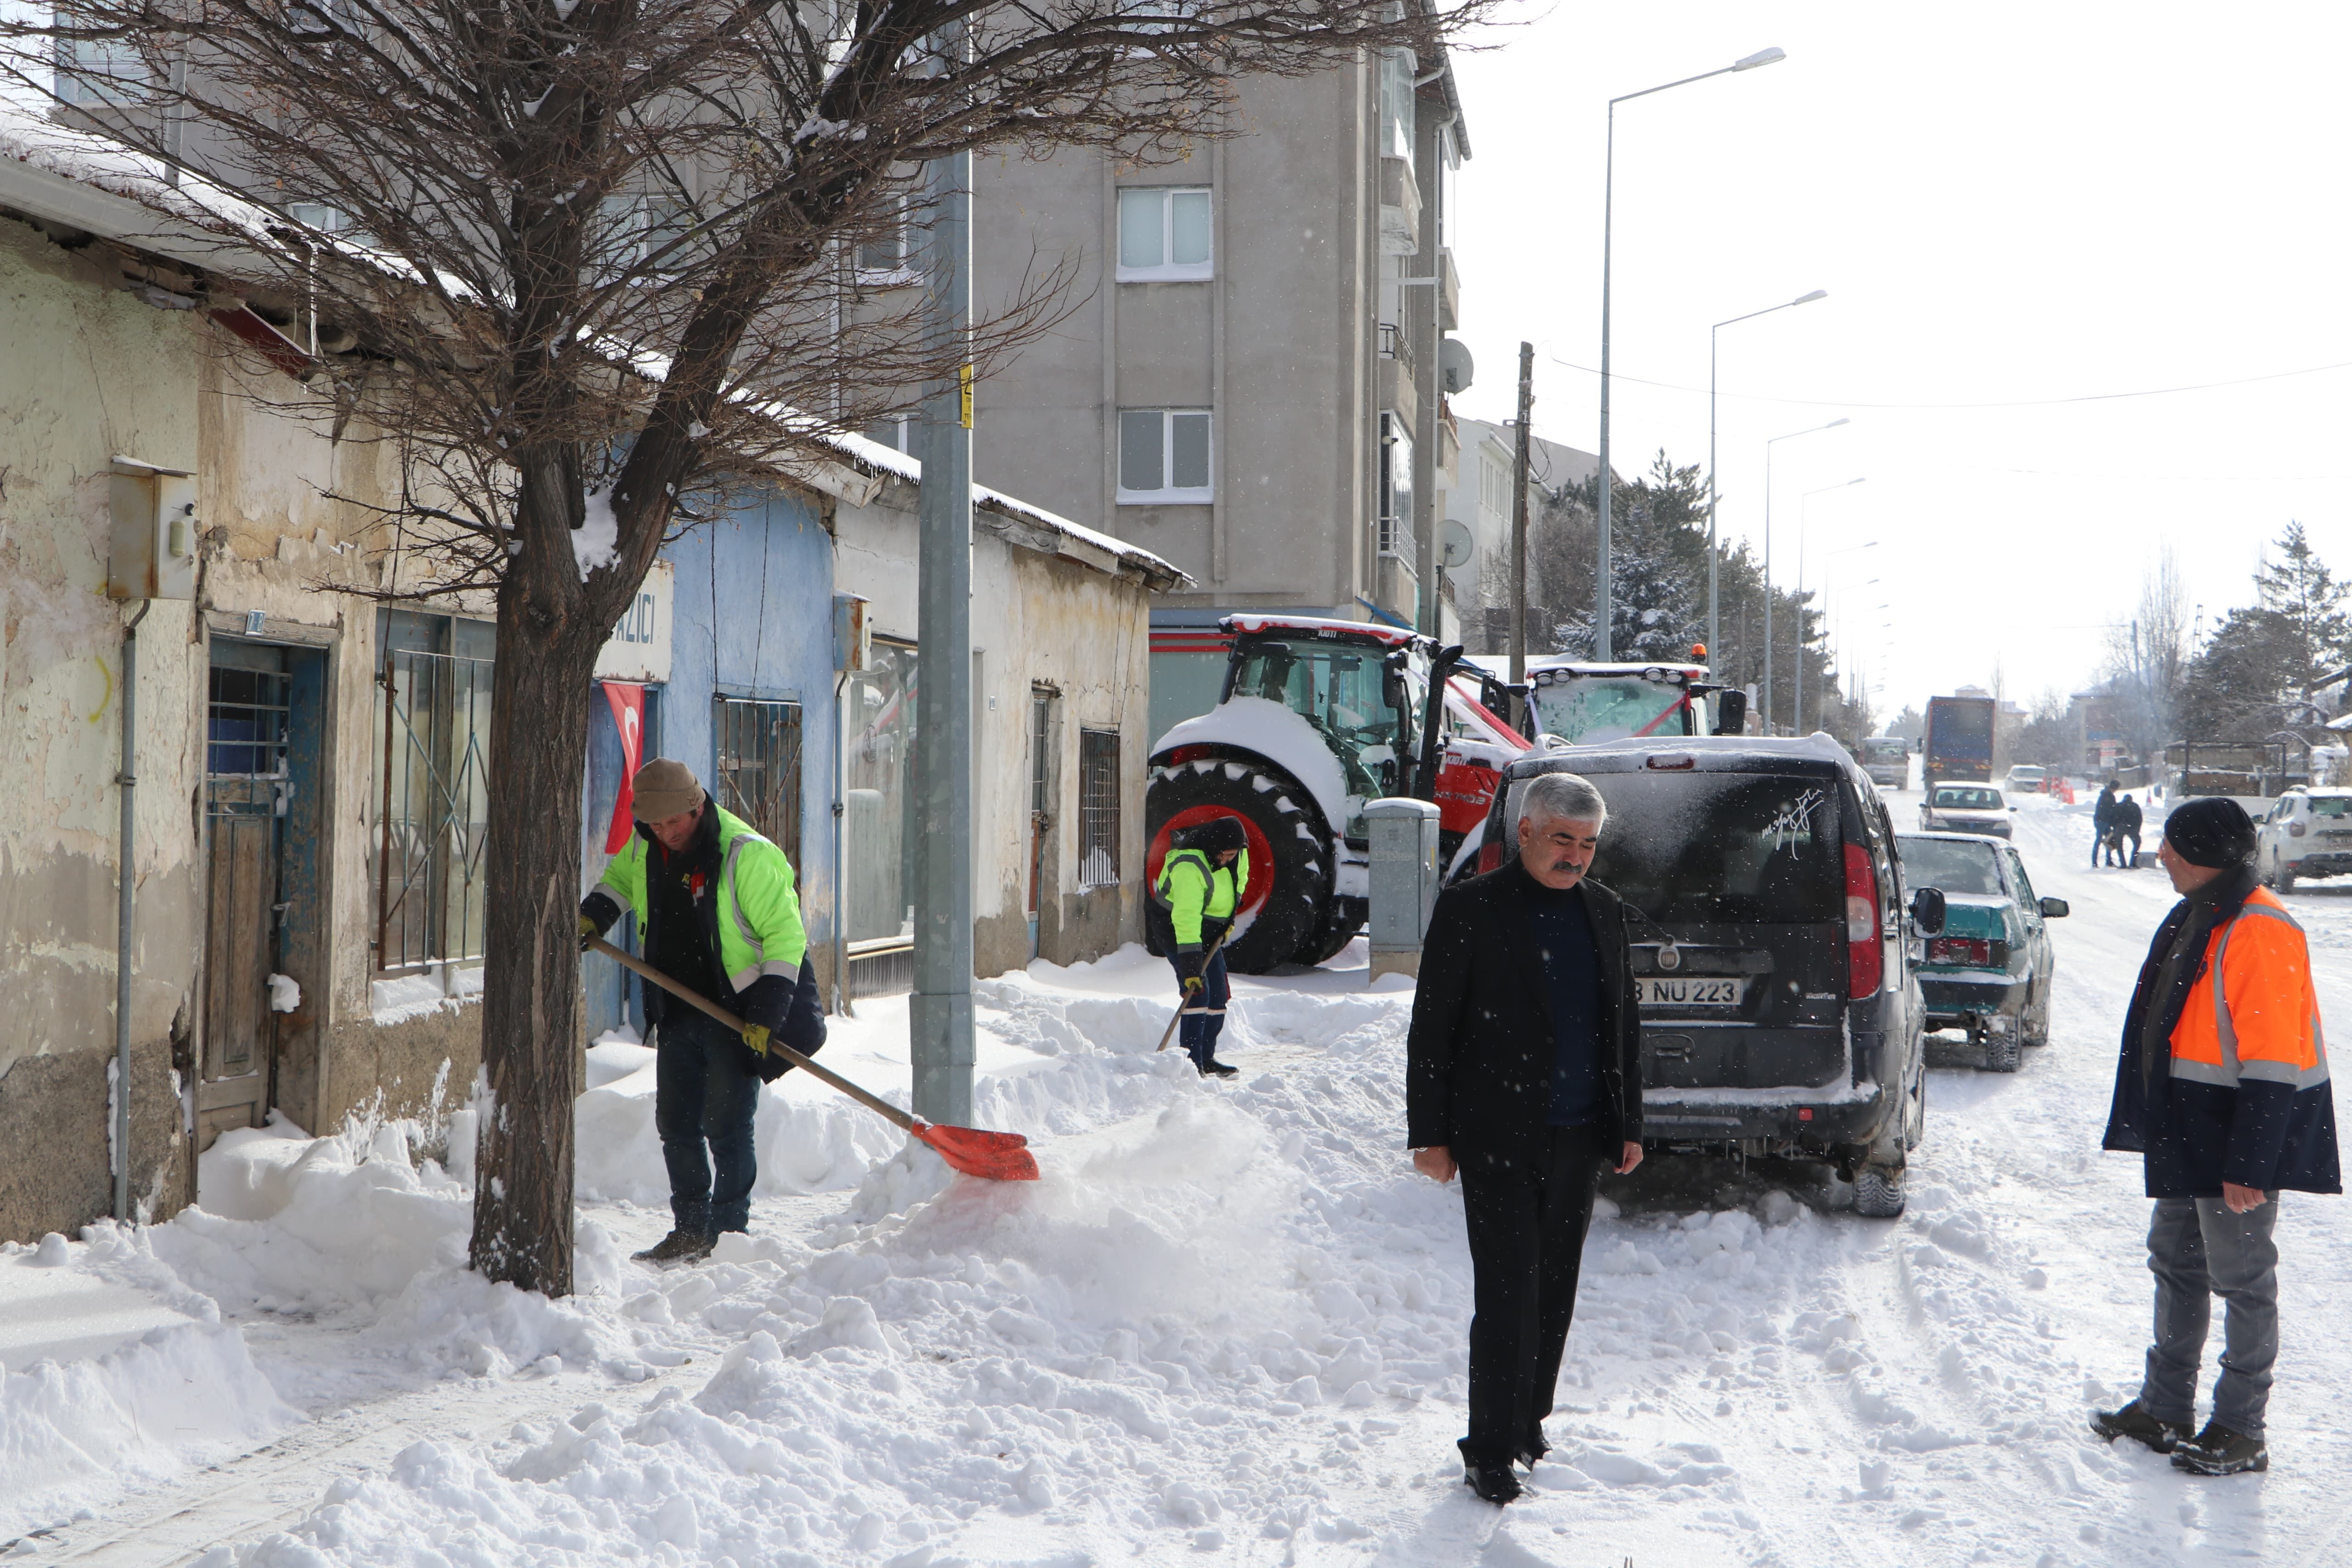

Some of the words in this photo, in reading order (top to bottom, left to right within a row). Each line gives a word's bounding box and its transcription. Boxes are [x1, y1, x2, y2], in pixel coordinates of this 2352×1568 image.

[610, 592, 655, 645] AZICI
[1317, 629, 1337, 638] KIOTI
[1654, 981, 1686, 1002] NU
[1692, 981, 1735, 1002] 223
